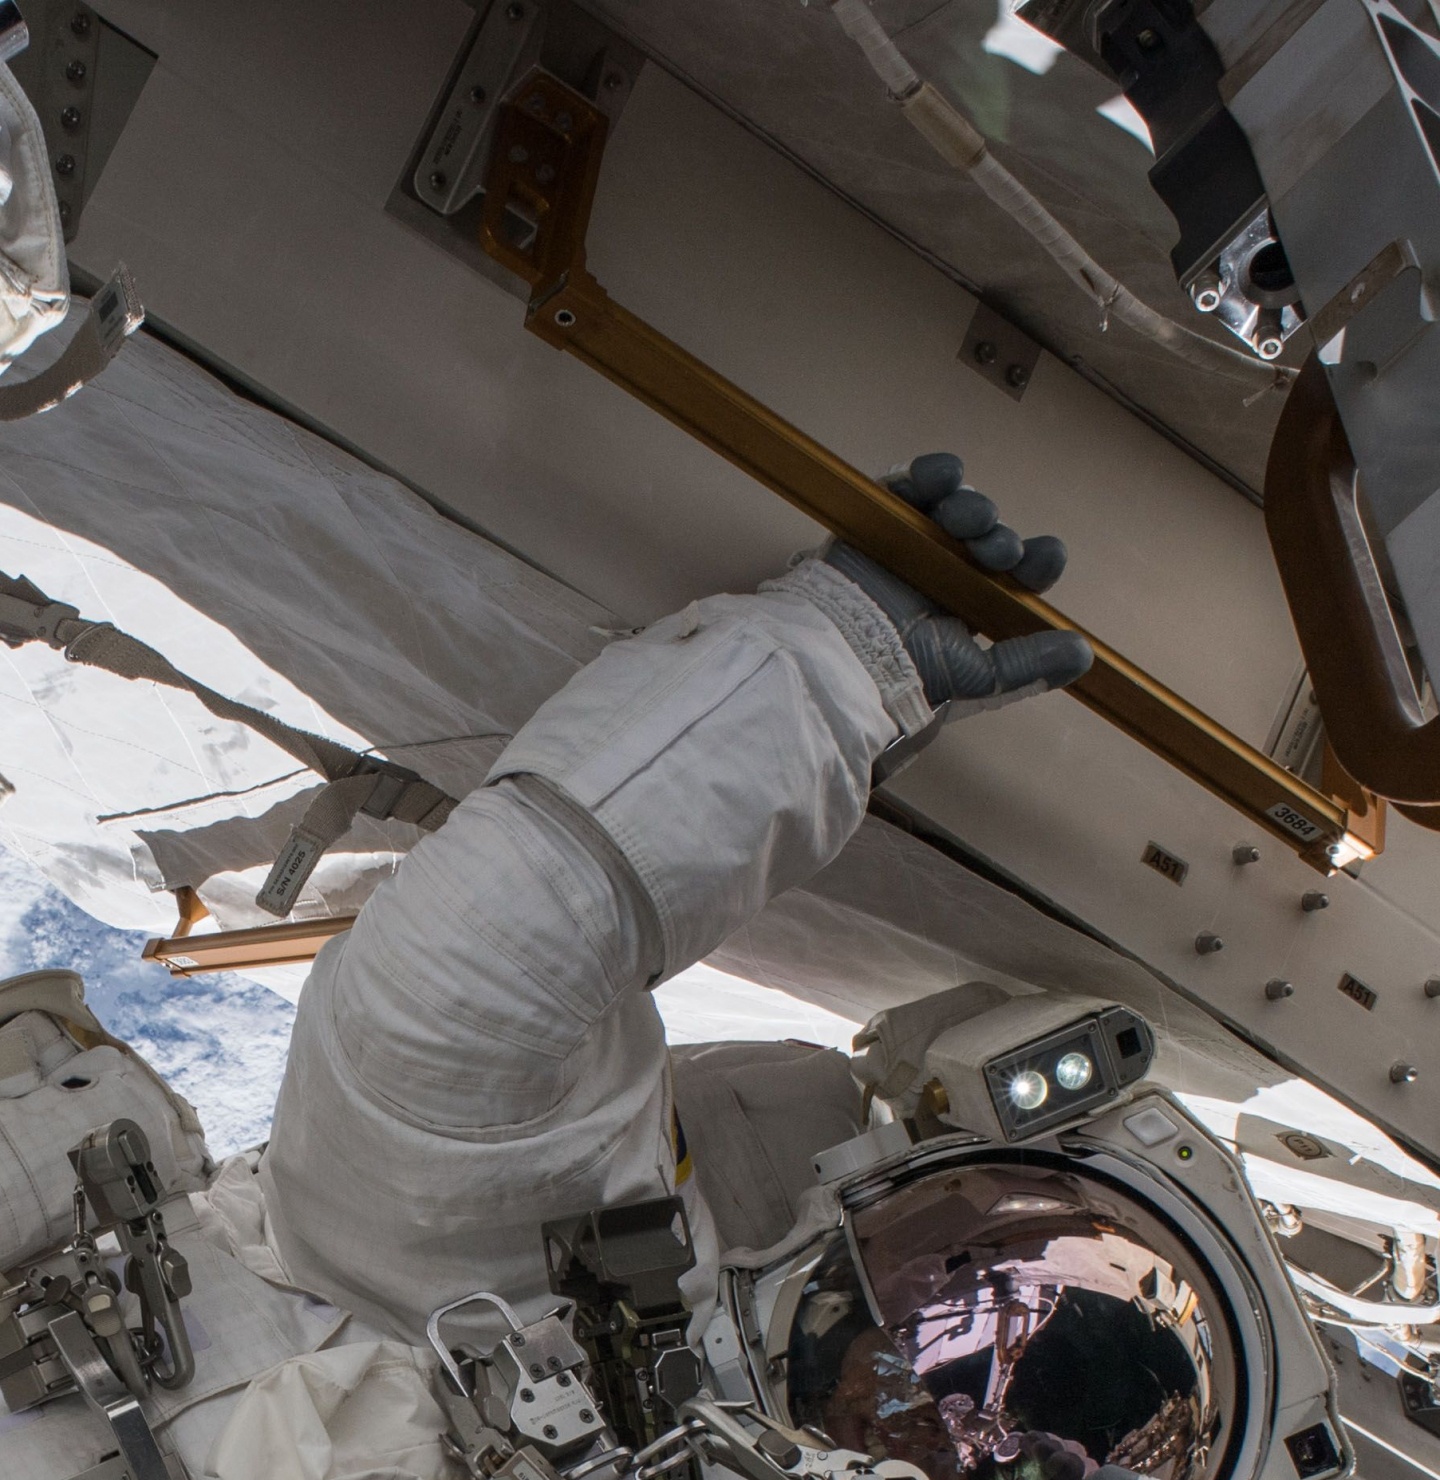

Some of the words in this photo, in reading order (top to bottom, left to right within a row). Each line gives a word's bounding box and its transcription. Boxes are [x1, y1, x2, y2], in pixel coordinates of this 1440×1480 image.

[1274, 806, 1316, 835] 3684
[275, 876, 290, 896] S/N
[287, 849, 306, 876] 4025
[1148, 848, 1181, 876] A51
[1342, 977, 1371, 1006] A51
